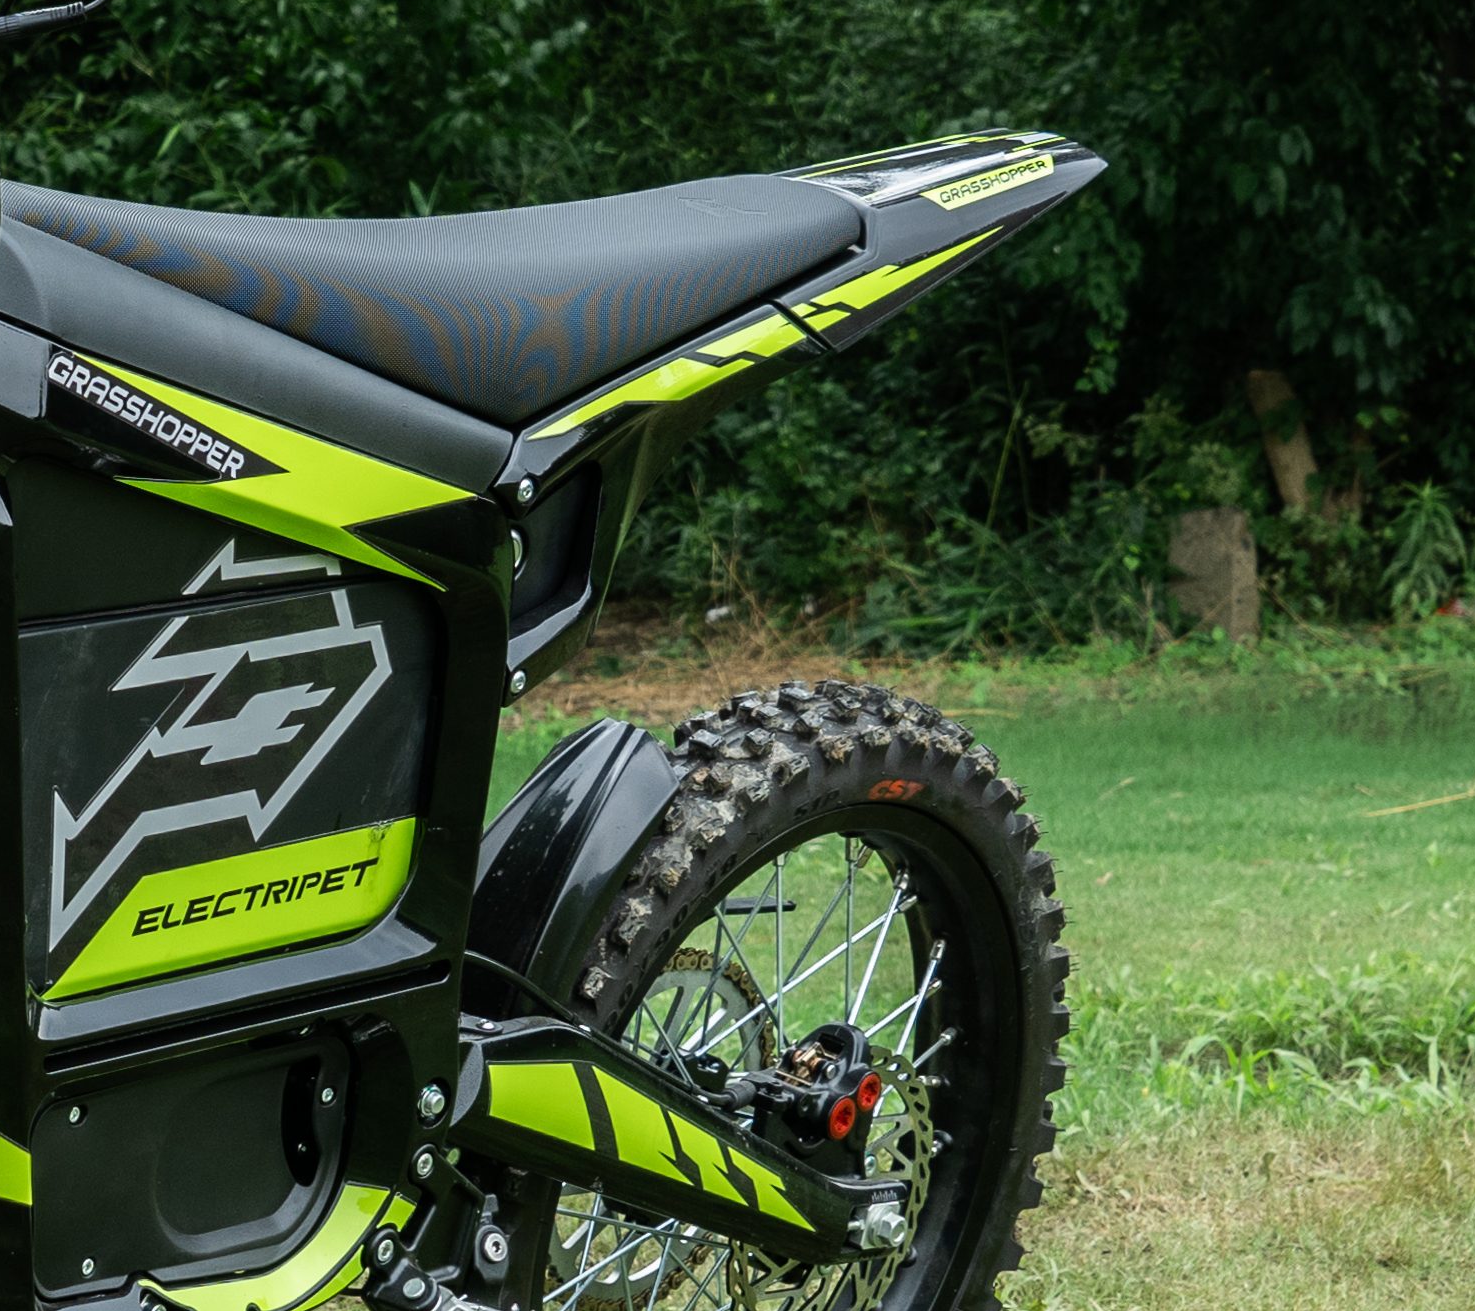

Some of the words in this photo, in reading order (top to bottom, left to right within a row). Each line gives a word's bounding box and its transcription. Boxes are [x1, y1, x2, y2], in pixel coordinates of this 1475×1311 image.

[939, 160, 1047, 203] GRASSHOPPER
[49, 354, 245, 479] GRASSHOPPER
[868, 779, 928, 801] CST
[131, 858, 379, 937] ELECTRIPET
